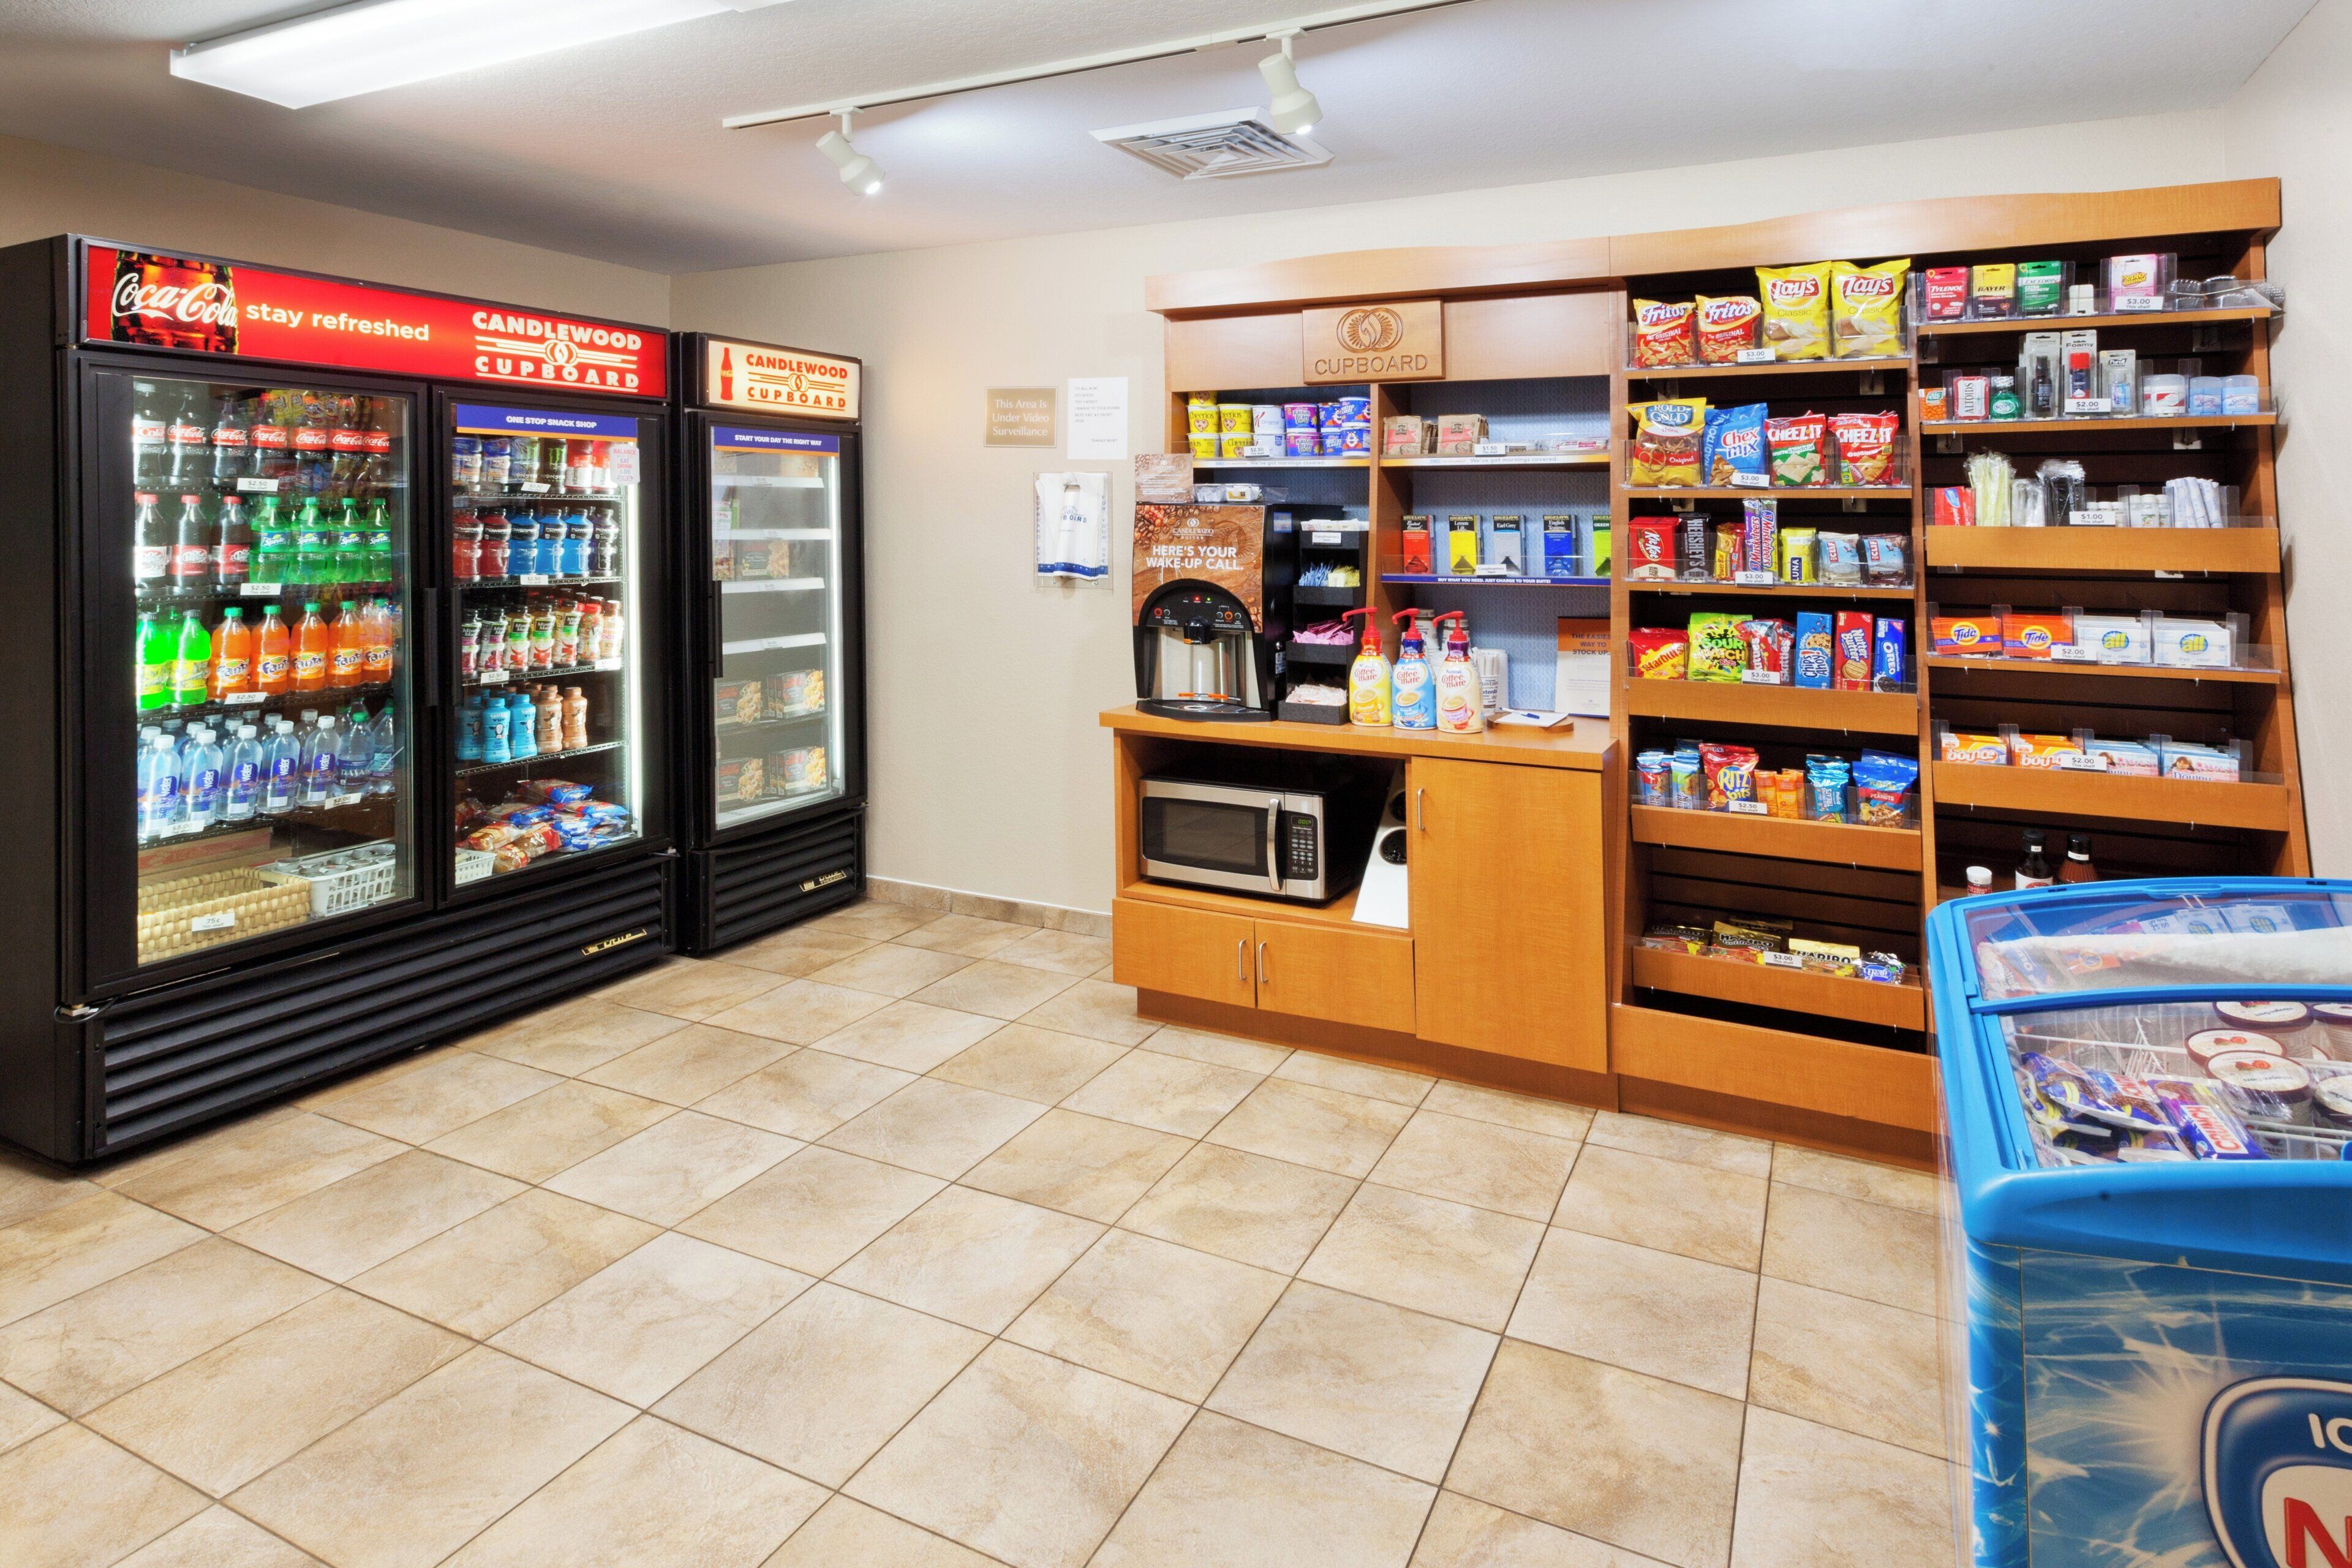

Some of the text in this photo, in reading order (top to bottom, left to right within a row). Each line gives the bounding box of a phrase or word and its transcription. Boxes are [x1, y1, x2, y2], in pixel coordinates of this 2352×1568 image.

[1844, 276, 1894, 296] Lay's
[1642, 304, 1687, 325] Fritos
[1705, 302, 1754, 324] Fritos
[1777, 308, 1812, 317] Classic
[1847, 306, 1885, 315] Classic
[246, 304, 429, 341] stay refreshed
[472, 311, 642, 351] CANDLEWOOD
[1655, 328, 1681, 339] ORIGINAL
[1715, 328, 1744, 339] ORIGINAL
[475, 355, 639, 388] CUPBOARD
[746, 353, 848, 379] CANDLEWOOD
[1314, 354, 1428, 376] CUPBOARD
[747, 386, 846, 408] CUPBOARD
[995, 399, 1047, 409] This Area Is
[1964, 383, 1973, 414] ALTOIDS
[1653, 404, 1685, 412] ROLD
[506, 415, 524, 424] ONE
[525, 417, 546, 425] STOP
[547, 418, 575, 427] SNACK
[992, 413, 1049, 423] Under Video
[1650, 411, 1689, 422] GOLD
[992, 426, 1048, 436] Surveillance
[1722, 427, 1760, 446] Chex
[1767, 424, 1823, 441] CHEEZ-IT
[1836, 427, 1892, 443] CHEEZ-IT
[1787, 444, 1815, 454] cheddar
[1669, 456, 1695, 465] Original
[1687, 518, 1706, 567] HERSHEY'S
[1749, 516, 1761, 565] Musketeers
[1762, 520, 1774, 568] Musketeers
[1153, 545, 1237, 558] HERE'S YOUR
[1869, 541, 1879, 557] CLIF
[1146, 557, 1244, 570] WAKE-UP CALL.
[1791, 559, 1800, 581] LUNA
[1953, 628, 1978, 641] Tide
[2024, 631, 2049, 644] Tide
[2103, 633, 2129, 650] all
[1702, 637, 1745, 649] SOUR
[1841, 633, 1860, 662] Butter
[1851, 628, 1868, 659] Nutter
[2180, 635, 2207, 653] all
[1719, 657, 1736, 666] Kids
[1883, 641, 1896, 674] OREO
[1802, 654, 1818, 678] Chips
[1358, 674, 1378, 682] mate
[1947, 747, 1998, 761] bounce
[1719, 767, 1750, 788] RITZ
[1726, 787, 1751, 801] bits
[1719, 933, 1774, 947] HARIBO
